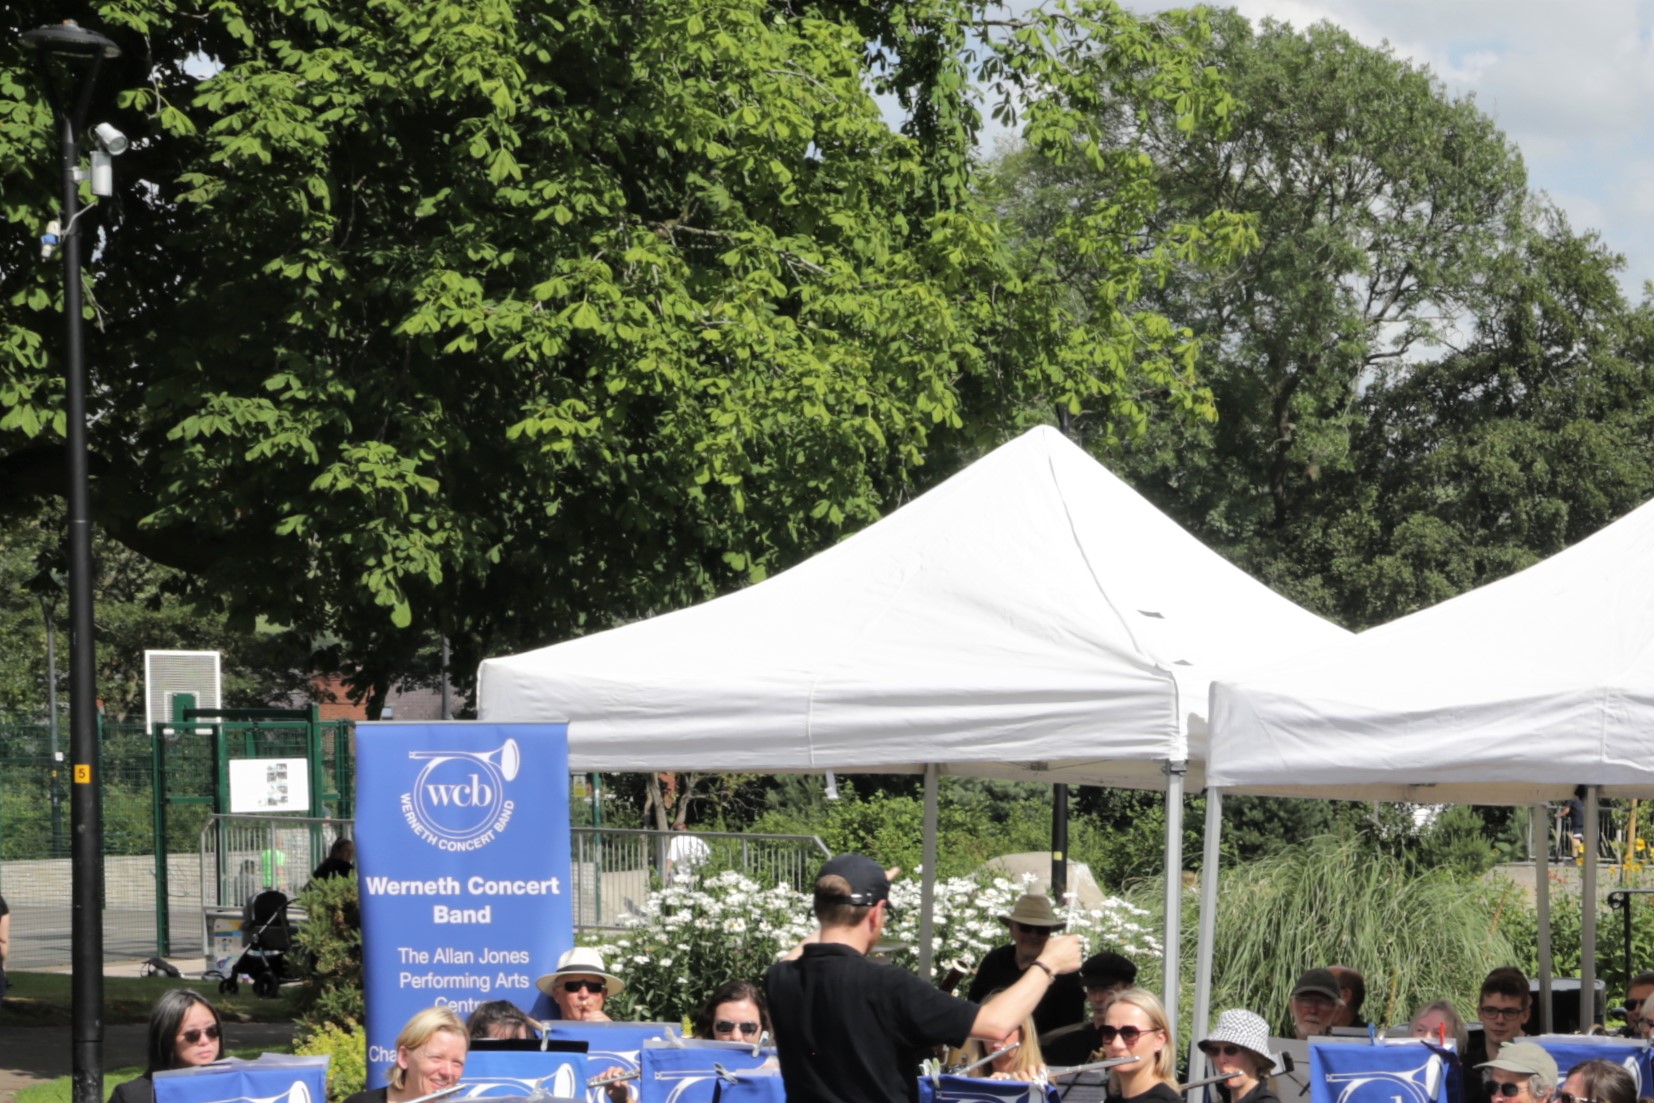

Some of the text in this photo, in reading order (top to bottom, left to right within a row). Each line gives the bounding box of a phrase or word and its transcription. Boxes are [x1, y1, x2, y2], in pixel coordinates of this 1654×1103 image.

[78, 769, 86, 779] 5
[425, 774, 492, 807] wcb
[400, 793, 514, 851] WERNETH CONCERT BAND
[366, 876, 561, 895] Werneth Concert
[433, 905, 491, 923] Band
[398, 948, 529, 964] The Allan Jones
[400, 972, 529, 992] Performing Arts
